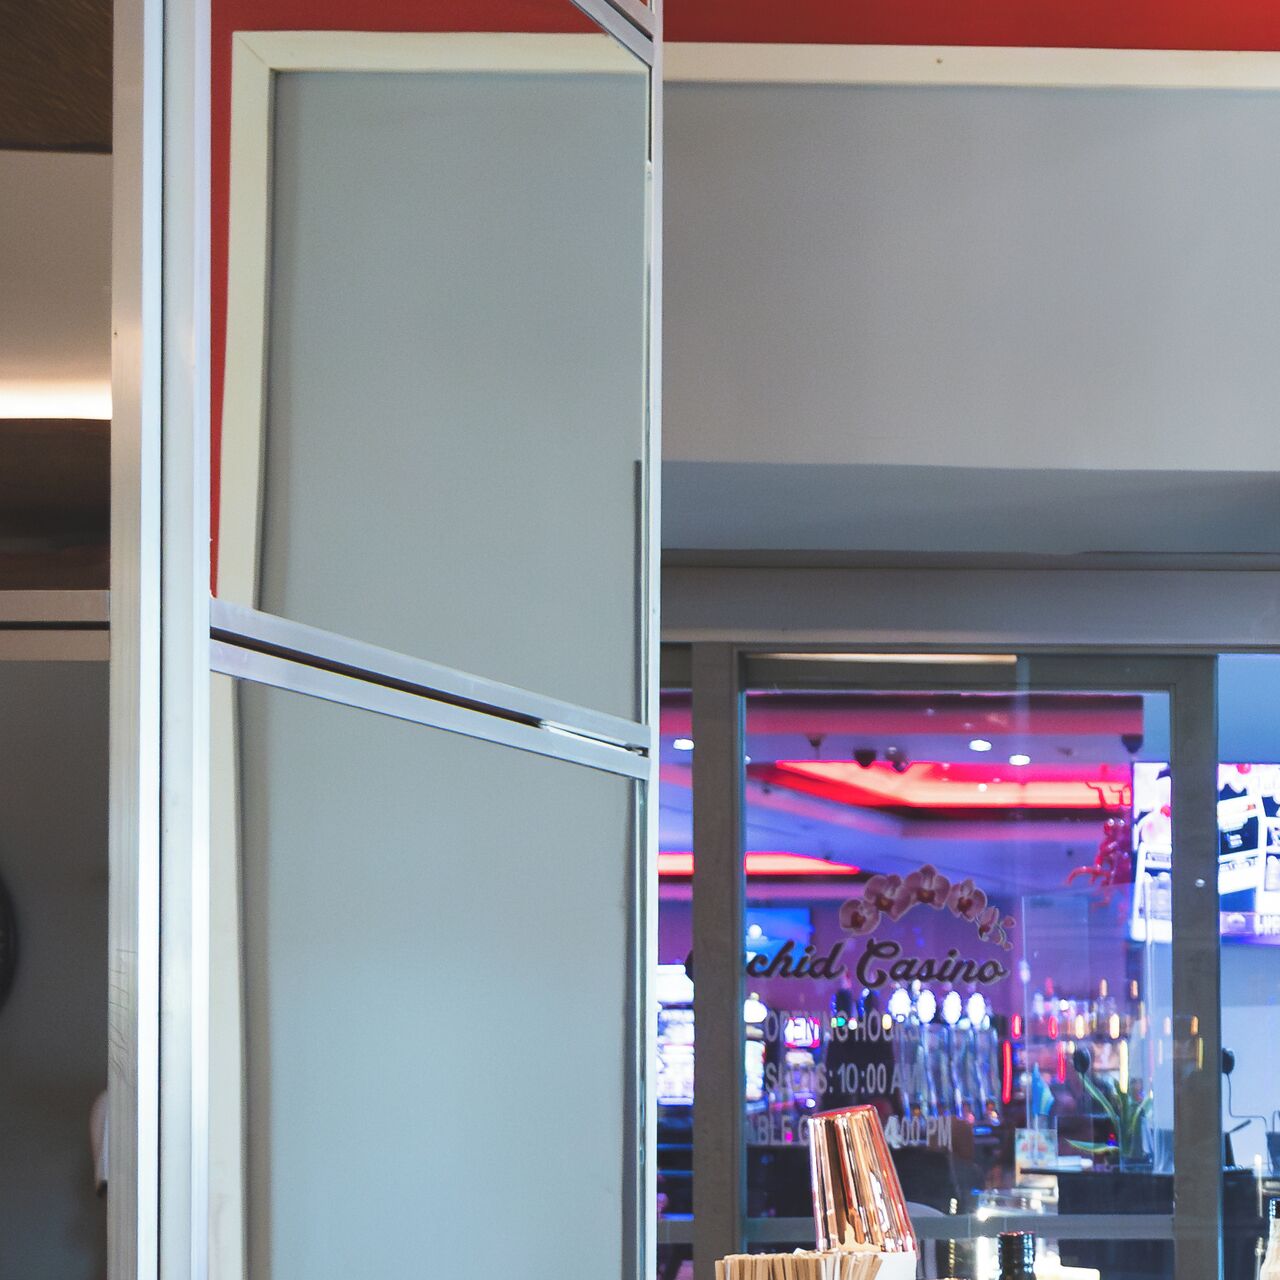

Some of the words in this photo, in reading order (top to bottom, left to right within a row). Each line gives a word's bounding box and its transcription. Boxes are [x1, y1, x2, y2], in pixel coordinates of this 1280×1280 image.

[745, 940, 846, 979] chid
[856, 939, 1008, 989] Casino
[837, 1061, 887, 1094] 10:00
